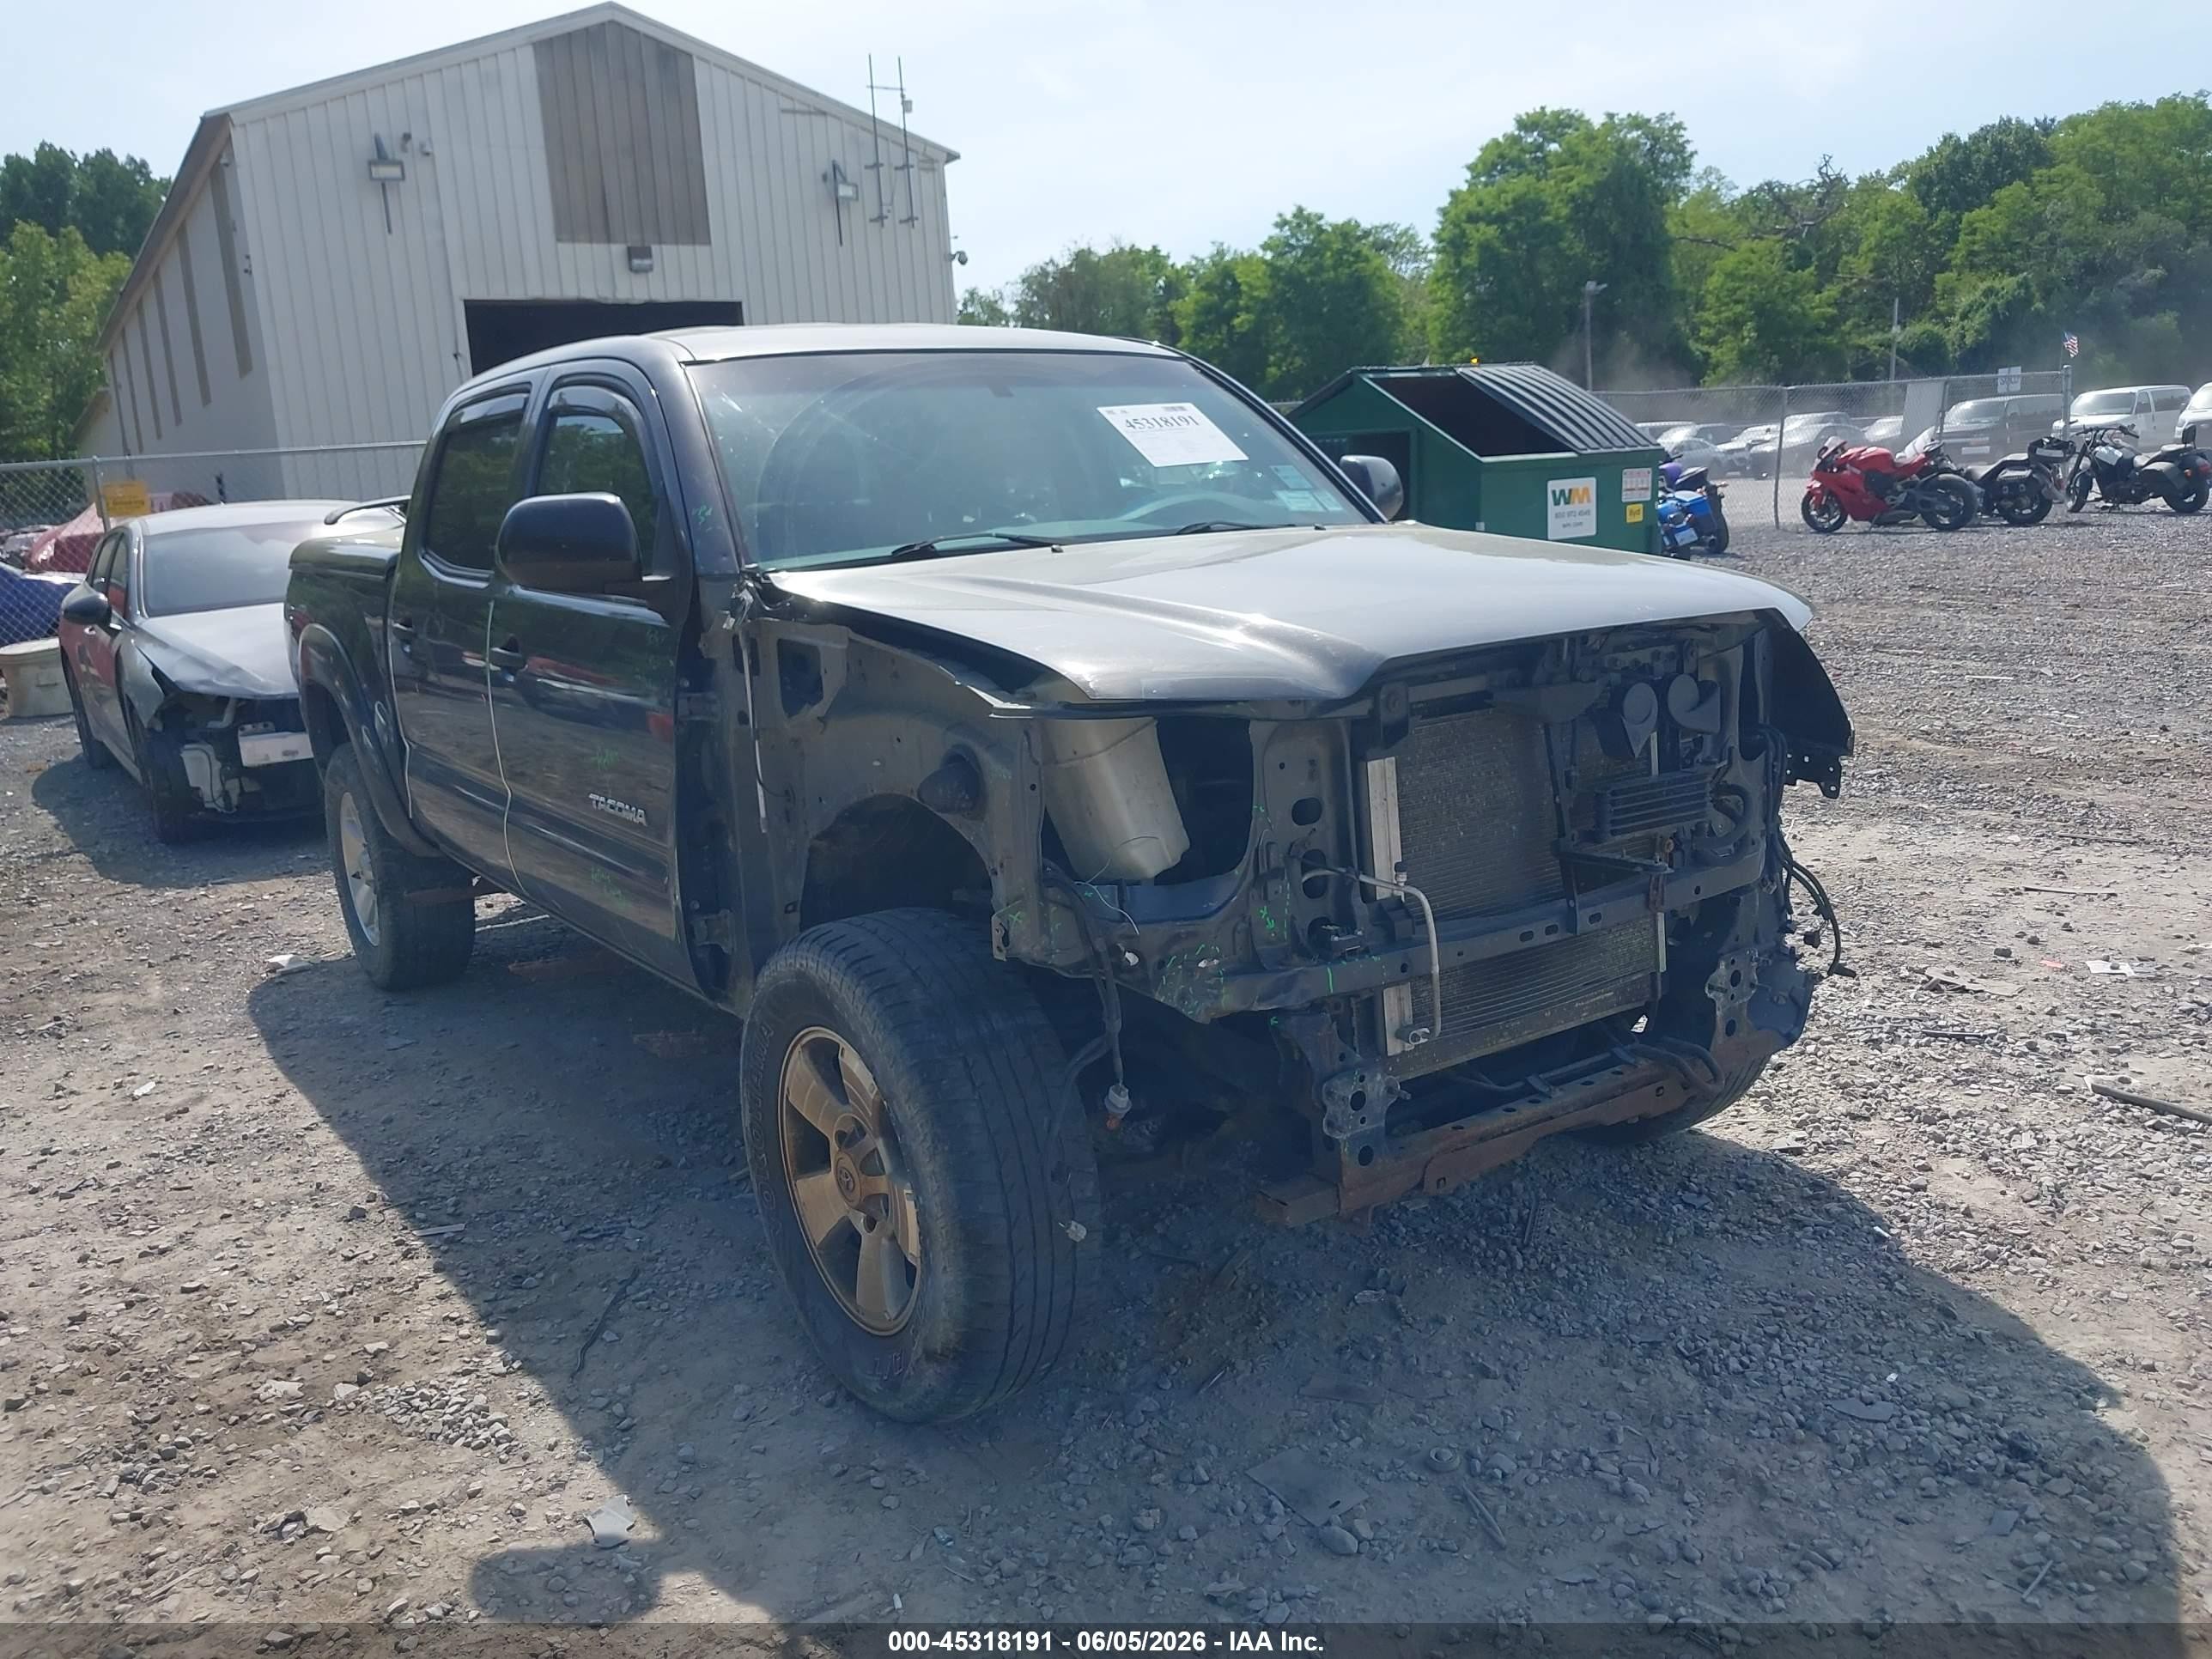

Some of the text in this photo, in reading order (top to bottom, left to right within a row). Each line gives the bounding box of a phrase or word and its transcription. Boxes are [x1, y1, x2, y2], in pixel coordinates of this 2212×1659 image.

[1125, 415, 1200, 430] 45318191
[1551, 487, 1591, 507] WM
[588, 793, 647, 827] TACOMA
